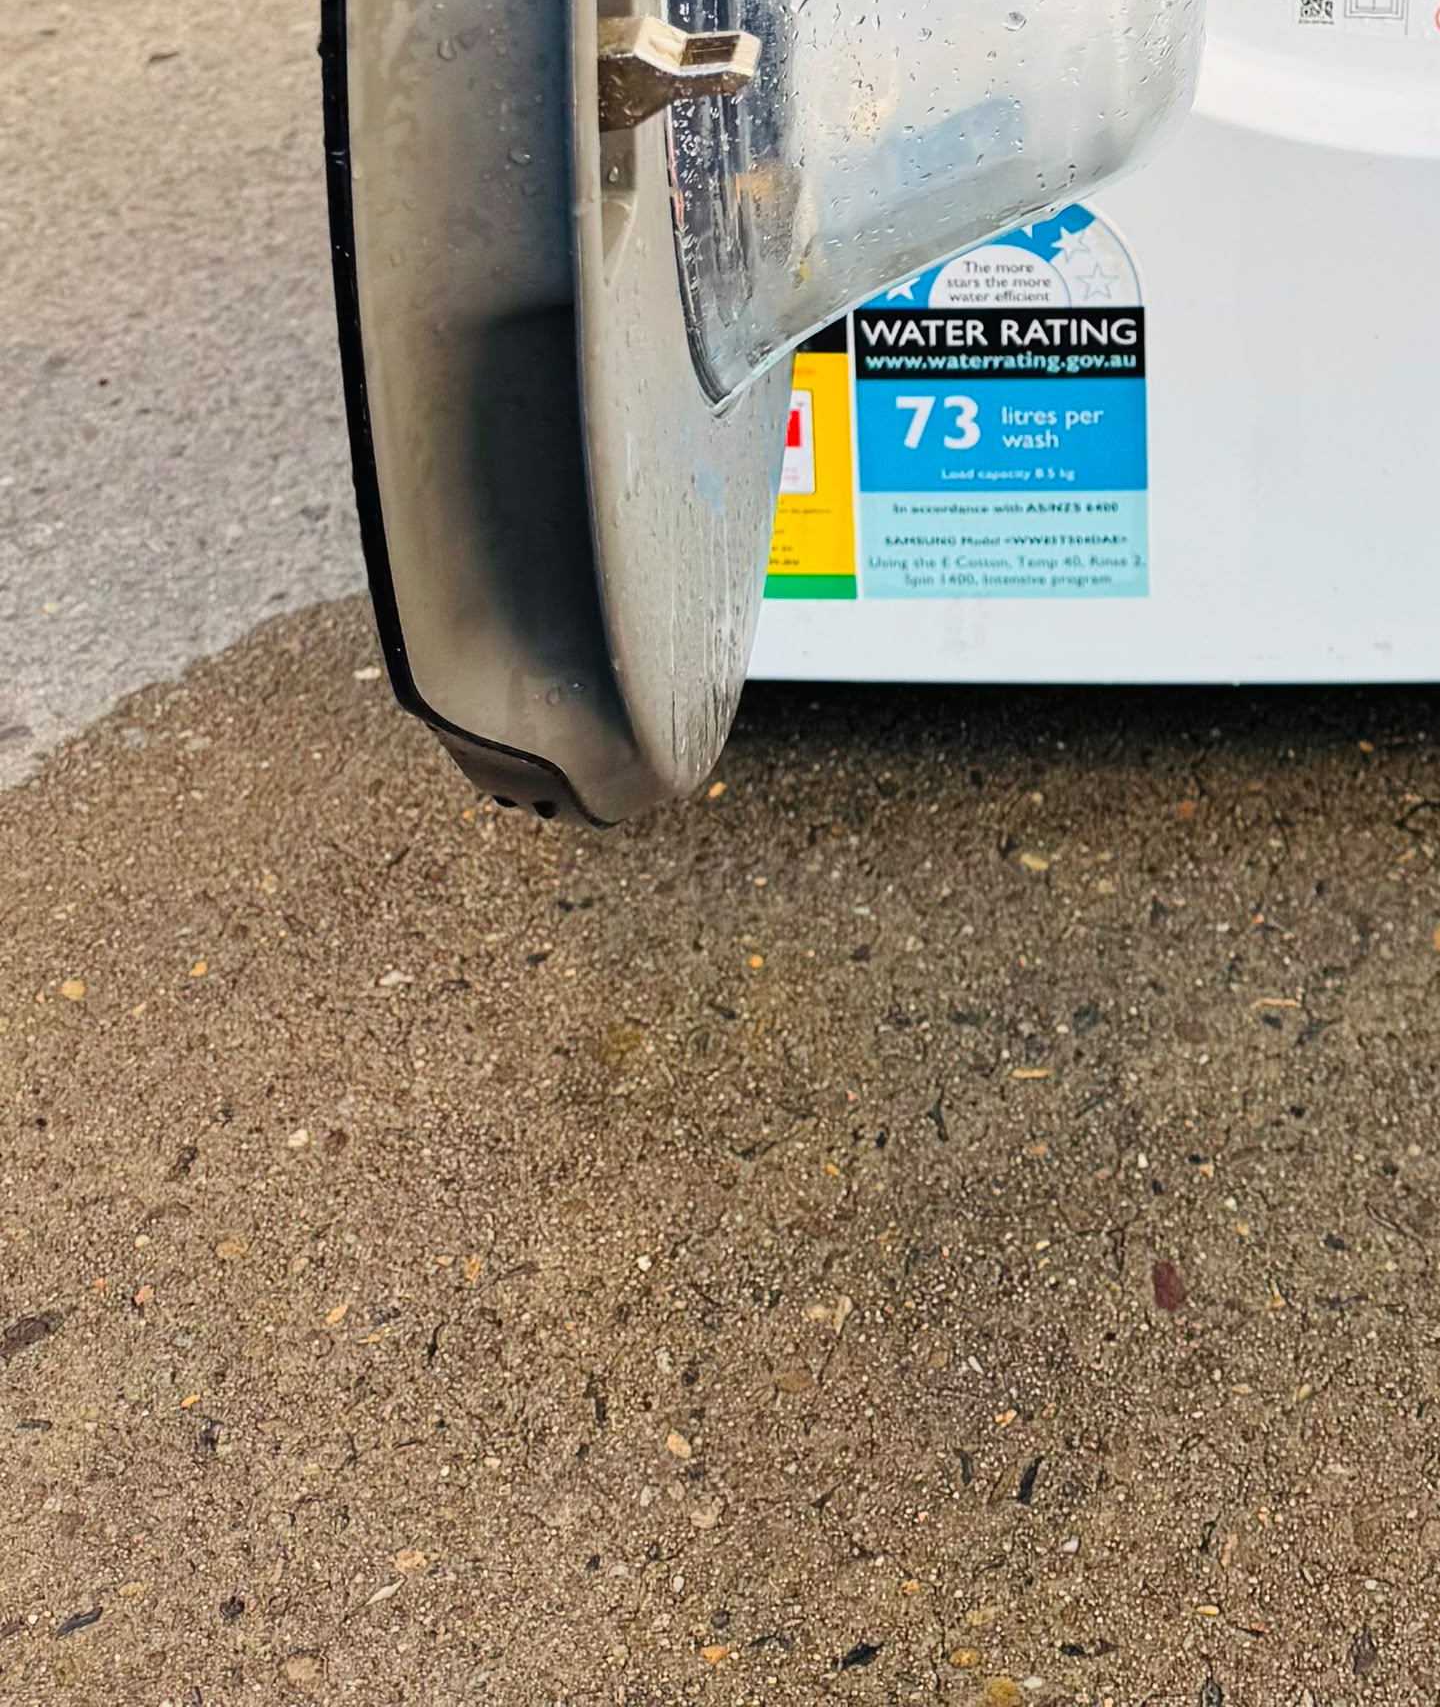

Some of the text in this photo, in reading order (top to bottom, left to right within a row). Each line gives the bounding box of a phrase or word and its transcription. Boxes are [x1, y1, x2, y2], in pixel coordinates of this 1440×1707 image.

[963, 260, 1034, 274] The more
[947, 275, 1051, 288] stars the more
[950, 290, 1050, 303] water efficient
[861, 318, 1137, 347] WATER RATING
[865, 350, 1136, 374] www.waterrating.gov.au
[895, 395, 1103, 450] 73 litres per
[1002, 429, 1059, 449] wash
[941, 468, 974, 480] Load
[977, 469, 1031, 482] capacity
[885, 535, 957, 546] SAMSUNG
[869, 555, 908, 570] Using
[914, 557, 936, 568] the
